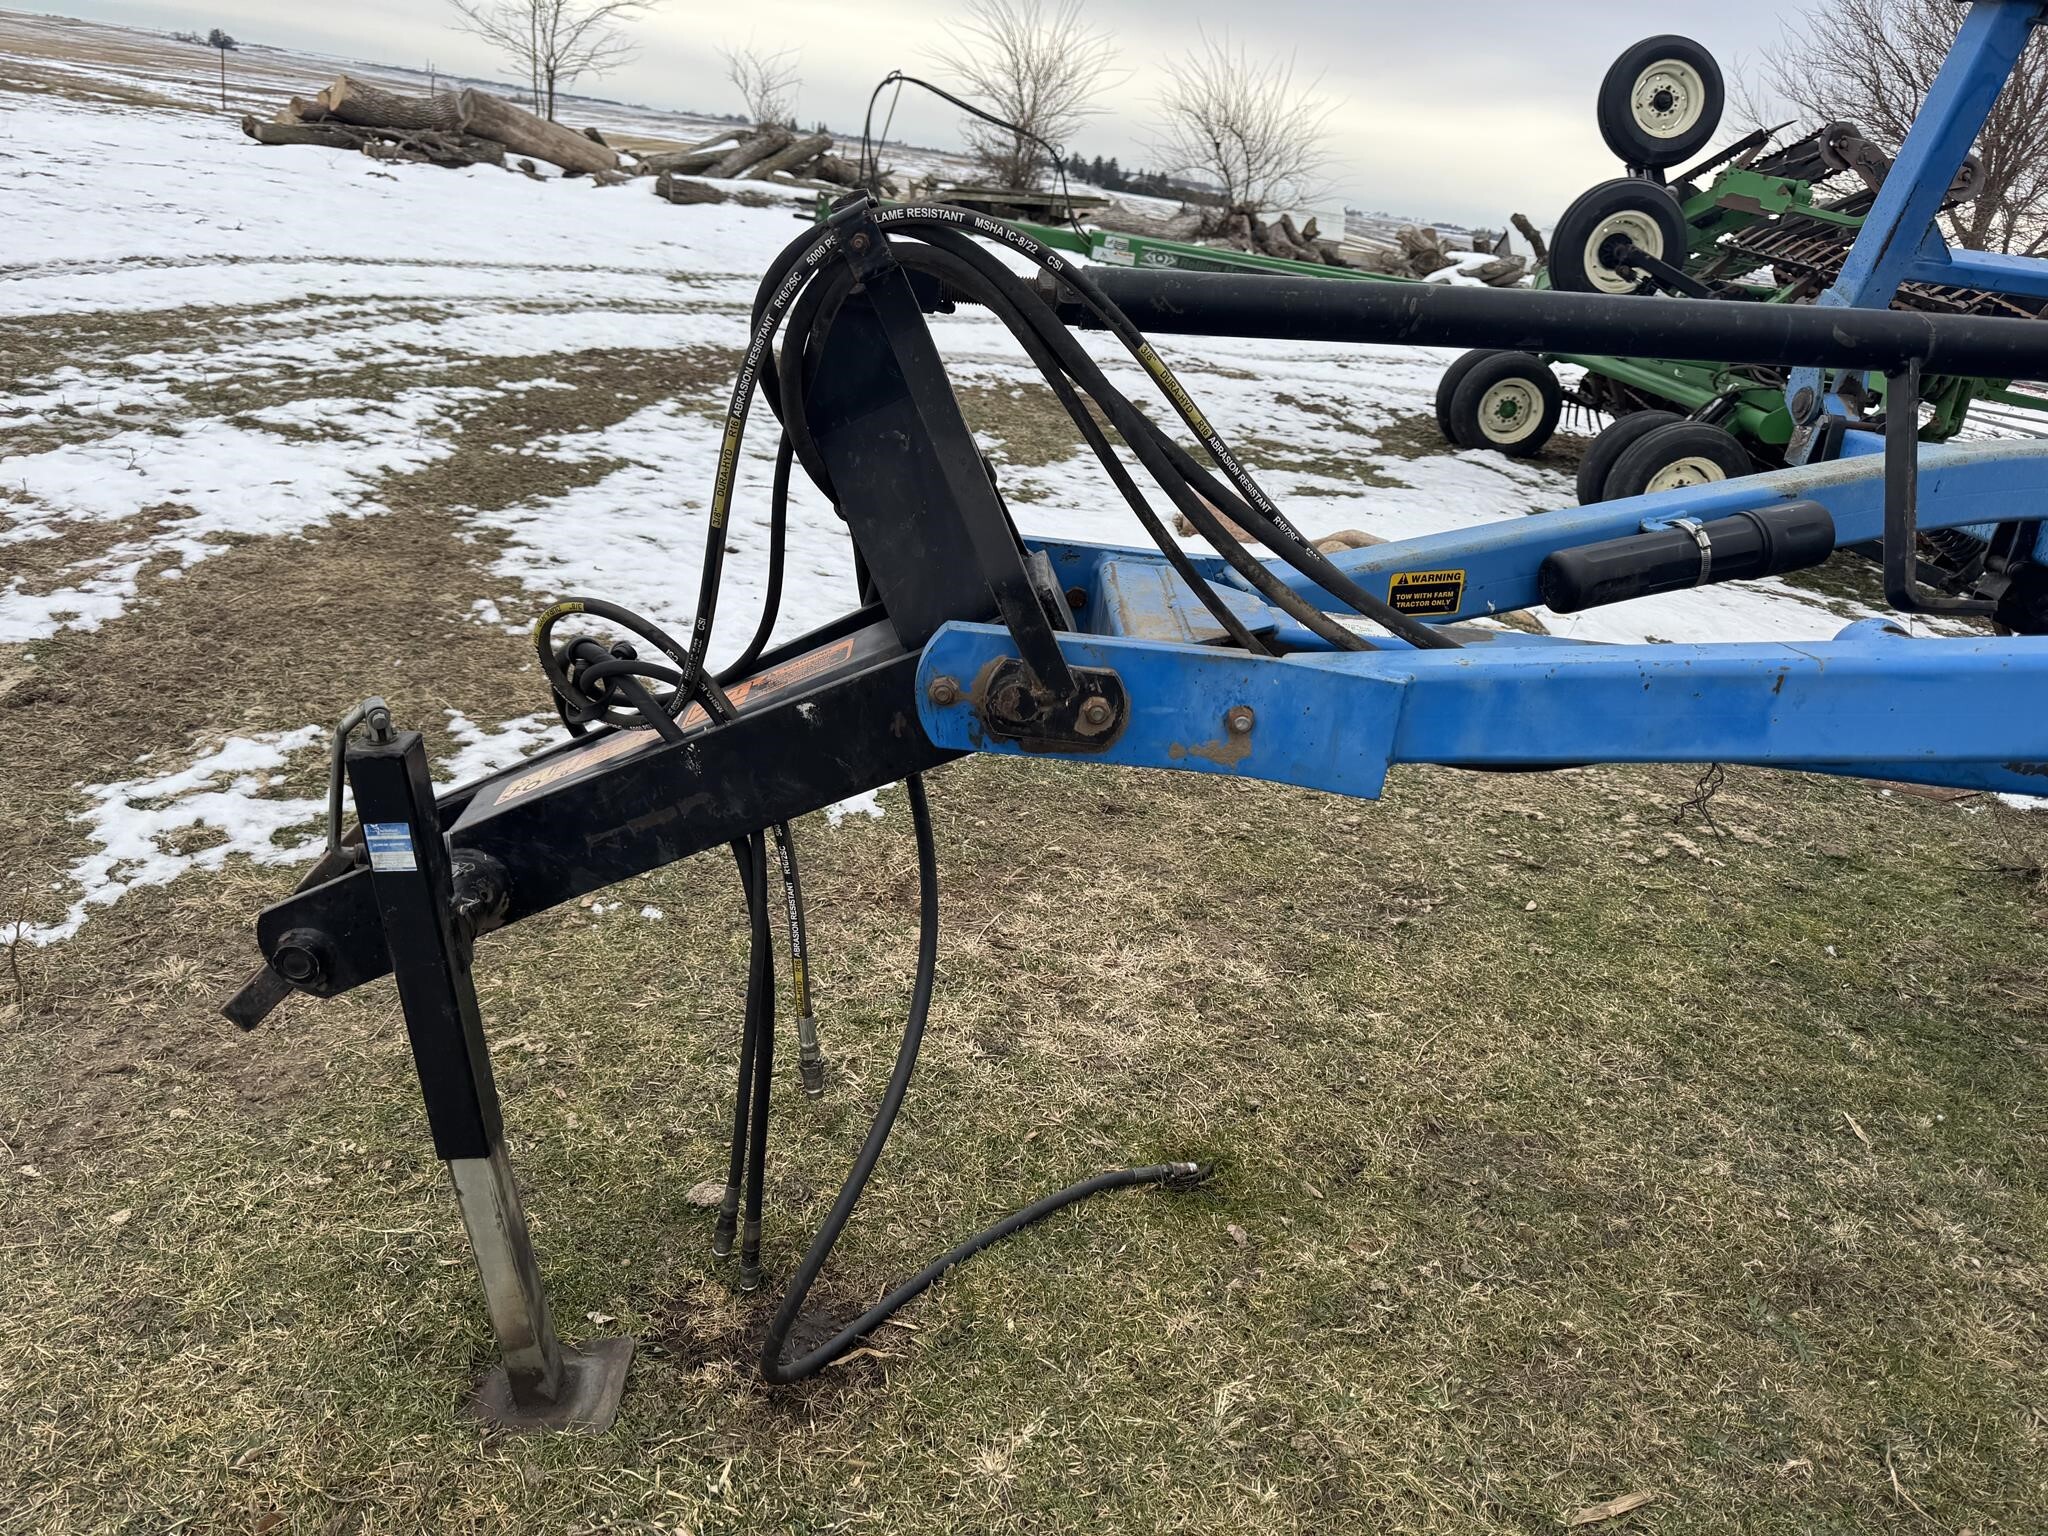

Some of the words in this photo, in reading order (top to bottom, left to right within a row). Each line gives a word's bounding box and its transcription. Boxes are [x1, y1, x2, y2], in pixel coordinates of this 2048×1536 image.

[825, 234, 838, 248] PS
[875, 208, 904, 224] LAME
[907, 207, 966, 223] RESISTANT
[974, 217, 1004, 237] MSHA
[1005, 229, 1039, 254] IC-8/22
[1047, 255, 1064, 272] CSI
[806, 244, 827, 266] 5000
[773, 271, 803, 309] R16/2SC
[747, 313, 776, 367] RESISTANT
[732, 367, 754, 418] ABRASION
[728, 420, 739, 438] R16
[1140, 346, 1157, 362] 3/8"
[1160, 370, 1194, 414] DURA-HYD
[1196, 419, 1211, 437] R16
[1208, 436, 1241, 476] ABRASION
[1237, 474, 1273, 513] RESISTANT
[1272, 515, 1300, 543] R16/2SC
[1411, 572, 1462, 583] WARNING
[1396, 600, 1430, 608] TRACTOR
[1414, 592, 1432, 600] WITH
[697, 617, 707, 631] CSI
[785, 881, 798, 920] RESISTANT
[790, 920, 801, 958] ABRASION
